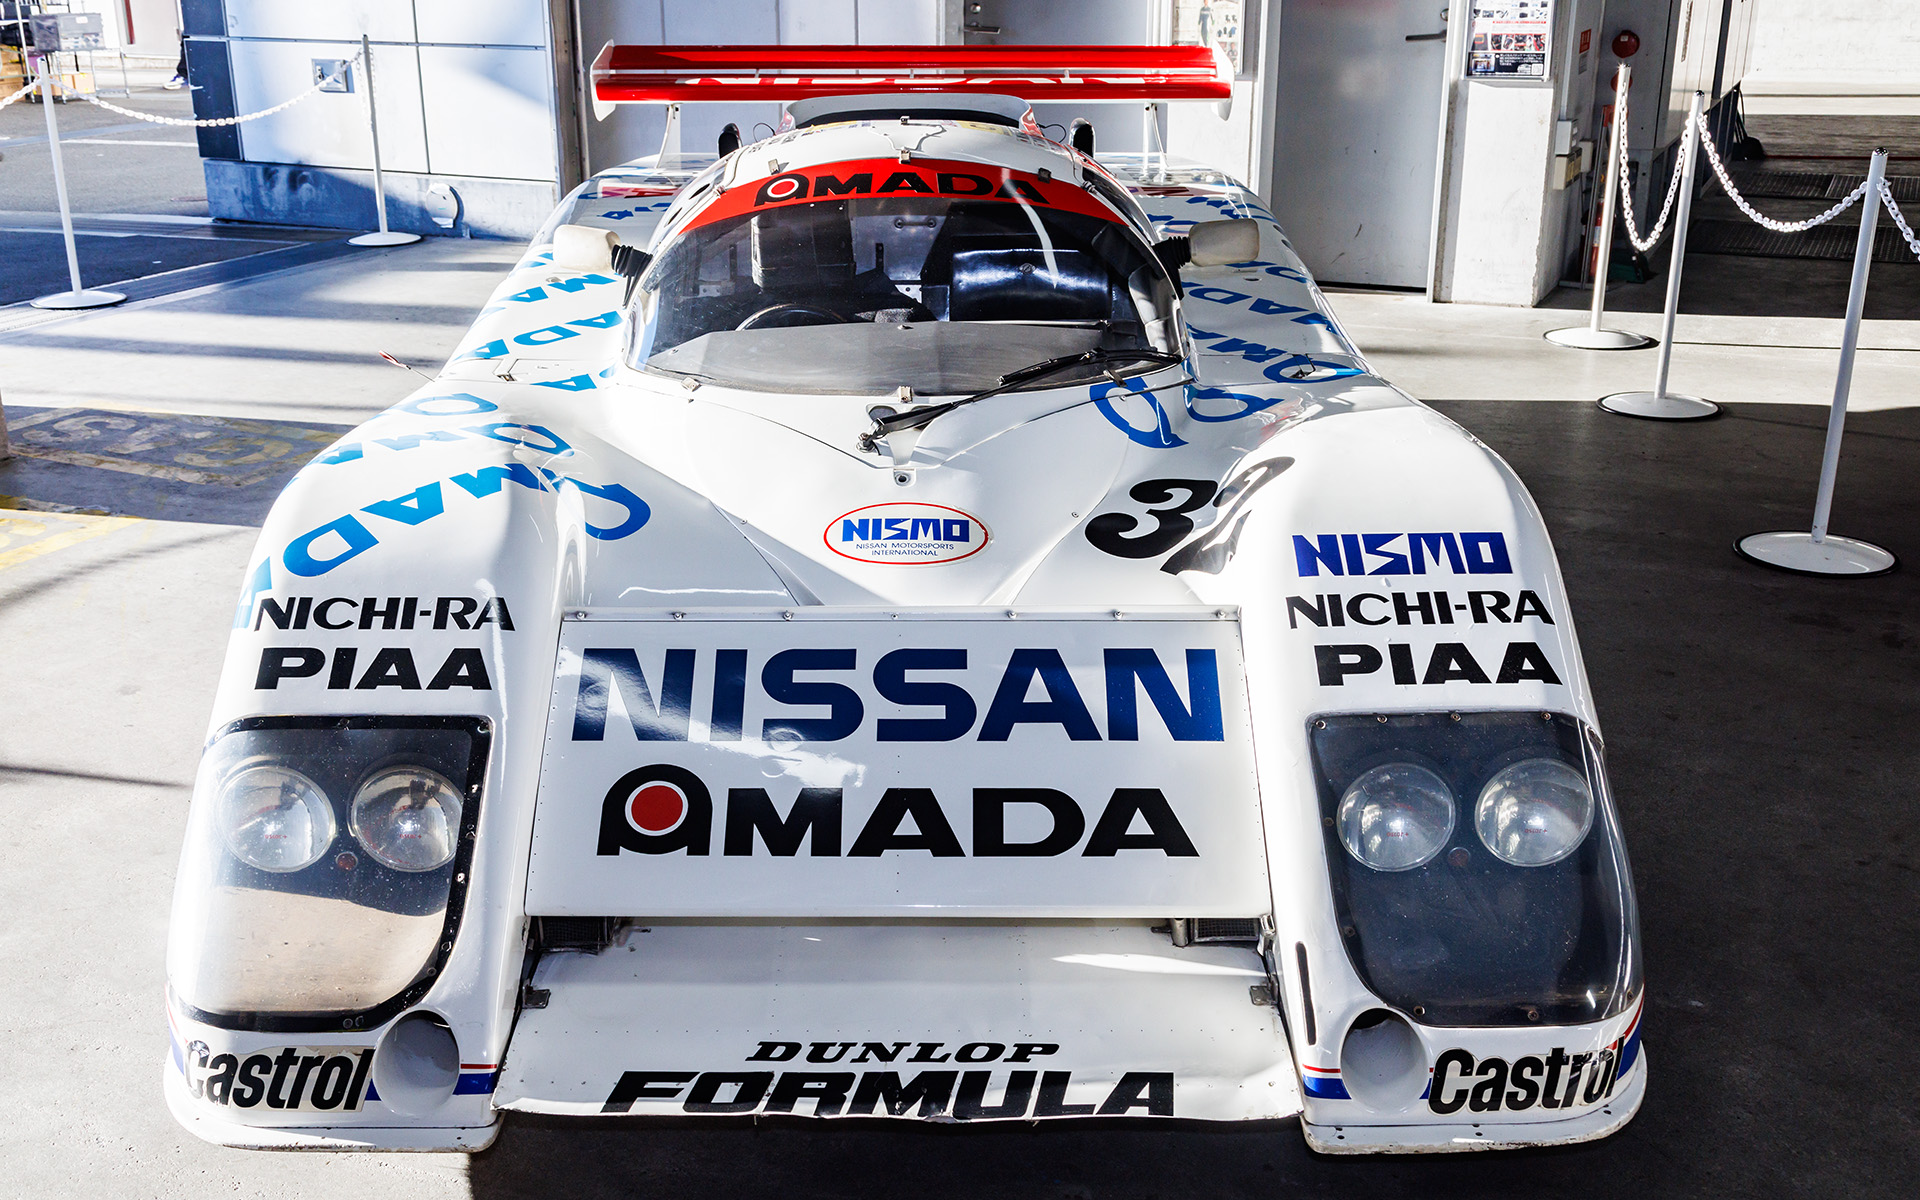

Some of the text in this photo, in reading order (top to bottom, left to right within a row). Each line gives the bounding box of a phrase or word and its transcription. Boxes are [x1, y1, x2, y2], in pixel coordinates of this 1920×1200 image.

[753, 171, 1051, 207] AMADA
[842, 518, 970, 542] NISMO
[872, 549, 938, 557] INTERNATIONAL
[1291, 532, 1513, 577] NISMO
[253, 597, 516, 631] NICHI-RA
[1285, 590, 1556, 629] NICHI-RA
[254, 647, 492, 690] PIAA
[1313, 641, 1563, 686] PIAA
[571, 647, 1225, 742] NISSAN
[596, 763, 1200, 857] AMADA
[744, 1041, 1061, 1063] DUNLOP
[184, 1040, 376, 1111] Castrol
[599, 1069, 1176, 1119] FORMULA
[1428, 1034, 1626, 1115] Castrol
